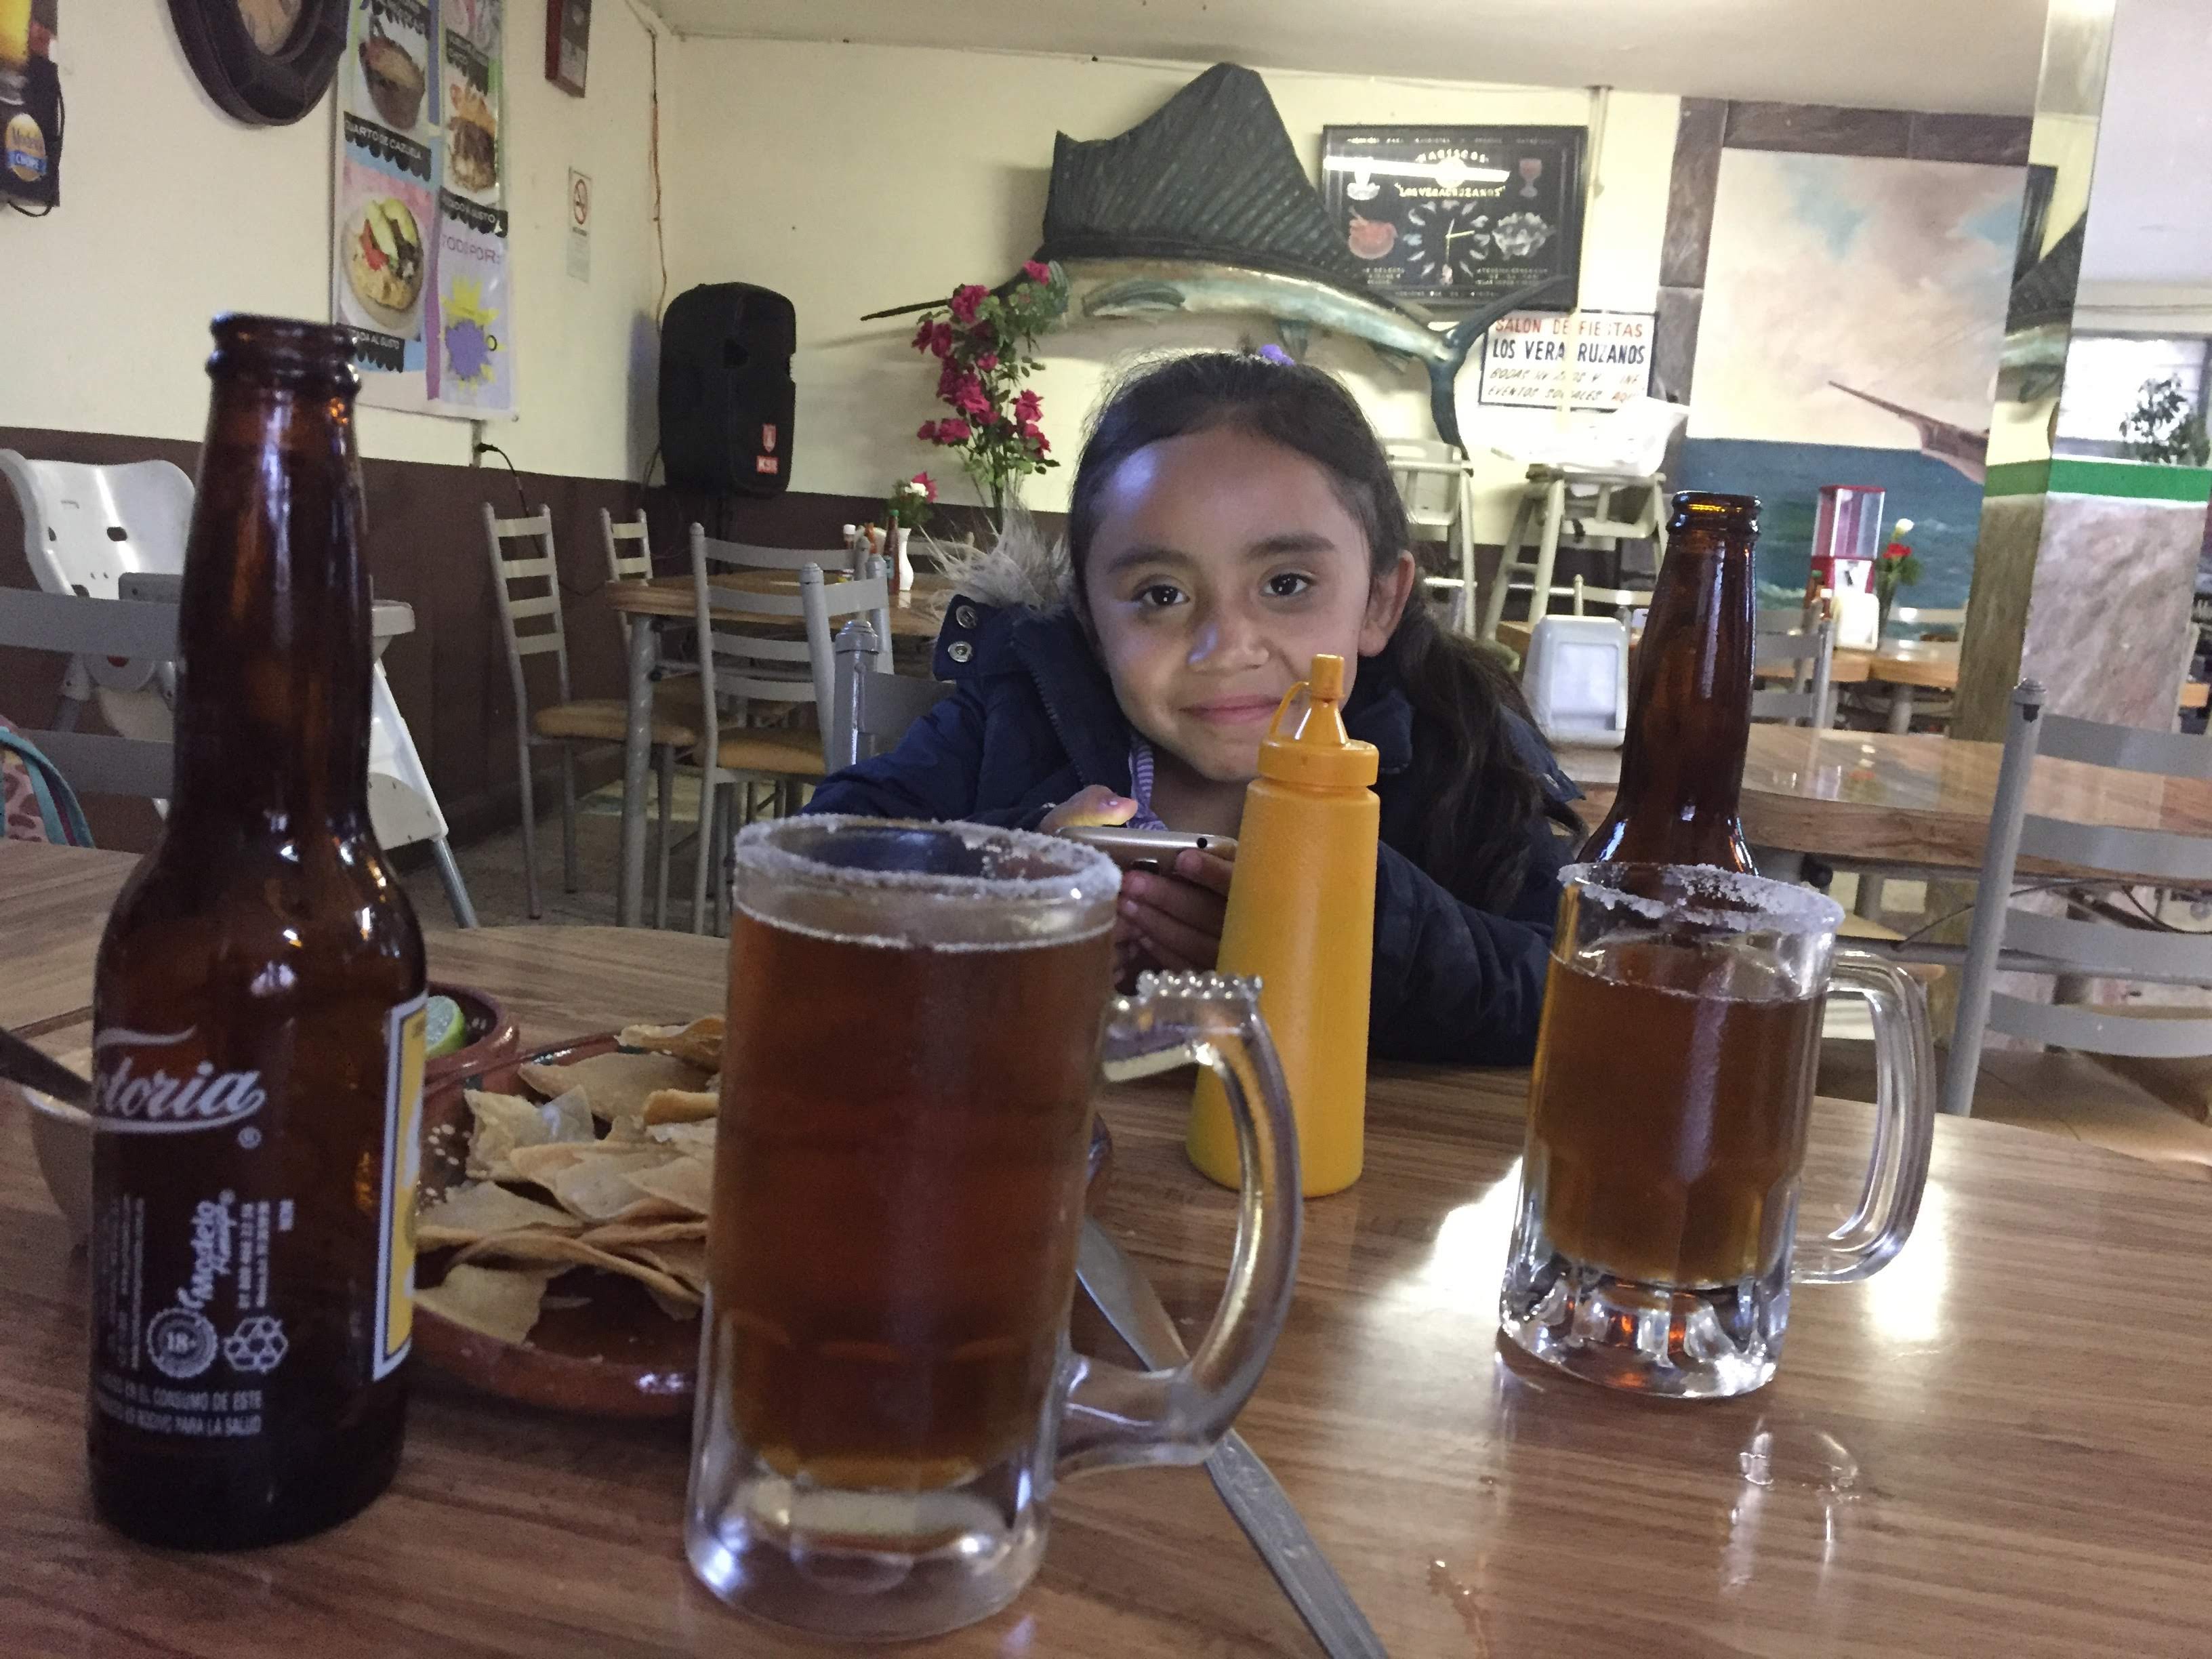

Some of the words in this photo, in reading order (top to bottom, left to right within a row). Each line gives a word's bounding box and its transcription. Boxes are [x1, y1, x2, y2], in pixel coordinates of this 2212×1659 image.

[1496, 317, 1542, 333] SALON
[1553, 319, 1570, 335] DE
[1493, 339, 1516, 359] LOS
[1525, 340, 1645, 365] VERARUZANOS
